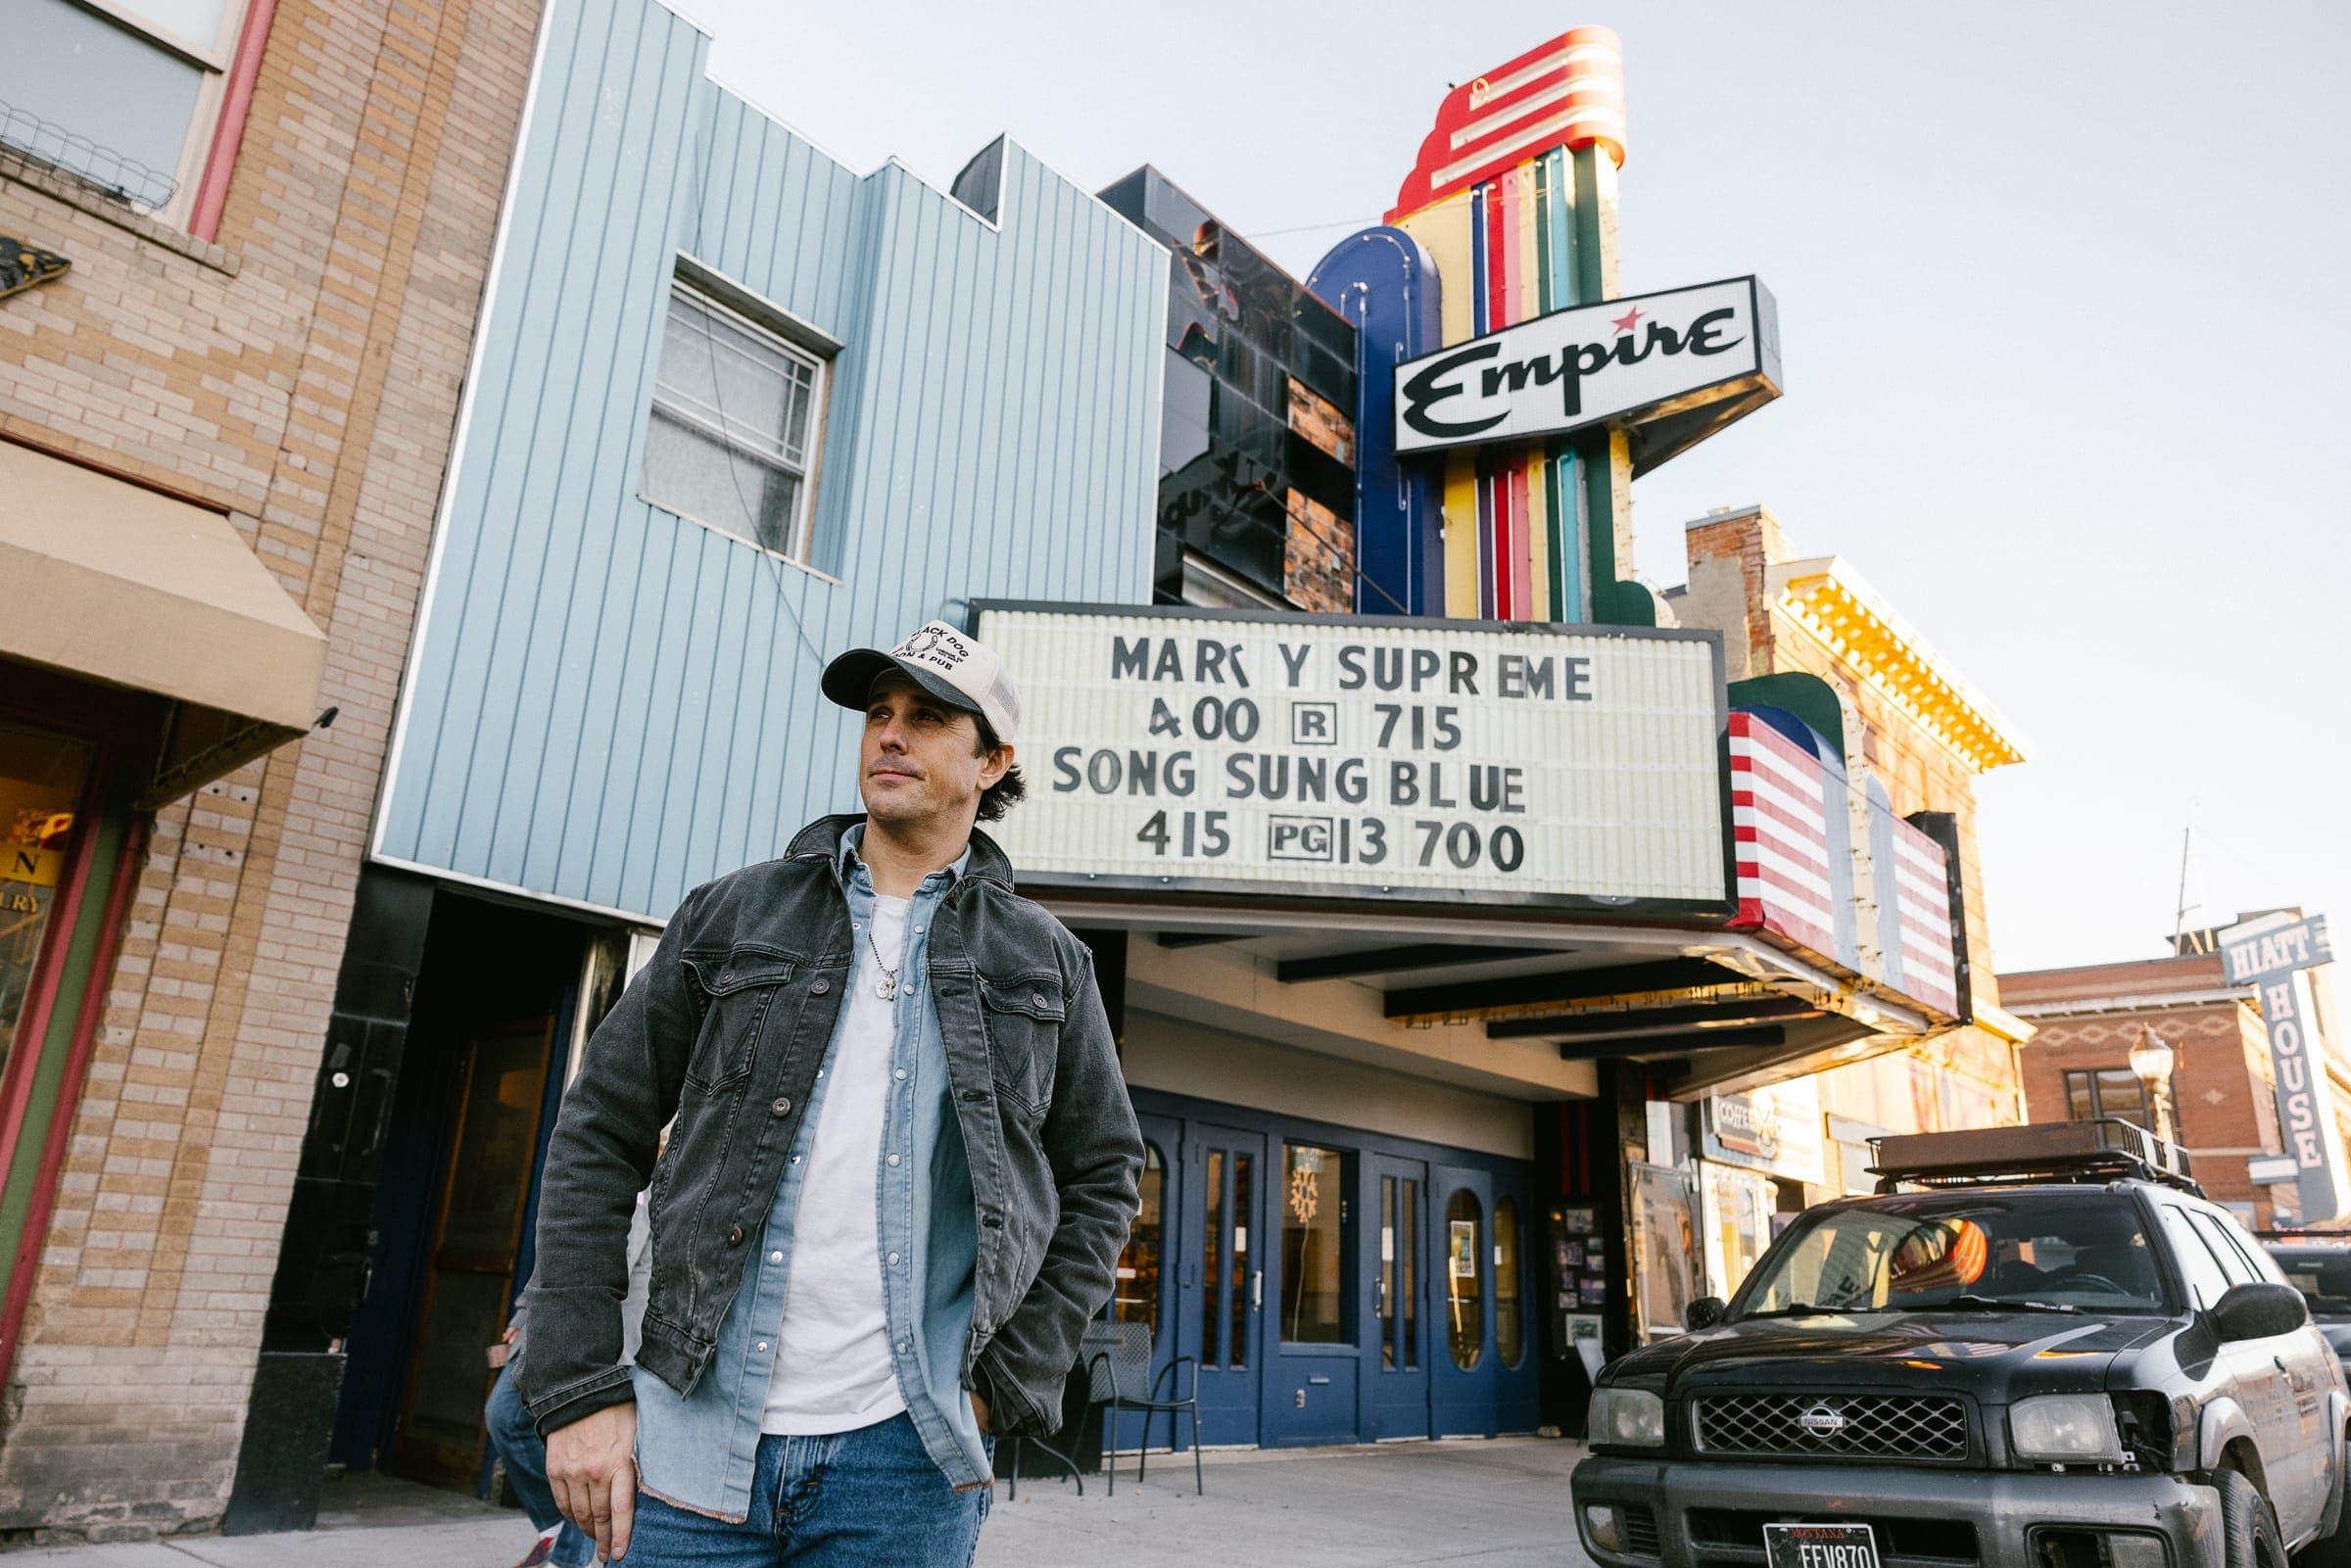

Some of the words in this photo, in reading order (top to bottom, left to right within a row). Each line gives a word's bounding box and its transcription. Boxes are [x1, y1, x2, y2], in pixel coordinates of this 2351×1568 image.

[1402, 307, 1746, 438] Empire
[929, 656, 953, 671] PUB
[946, 637, 969, 657] DOG
[1338, 645, 1593, 701] SUPREME
[1149, 696, 1260, 743] 400
[1301, 710, 1327, 737] R
[1374, 703, 1462, 751] 715
[1053, 746, 1195, 797] SONG
[1225, 752, 1368, 804] SUNG
[1390, 760, 1526, 814] BLUE
[1136, 809, 1230, 858] 415
[1415, 820, 1524, 873] 700
[2229, 924, 2310, 981] HIATT
[2265, 982, 2323, 1169] HOUSE
[1803, 1417, 1839, 1426] NISSAN
[1791, 1528, 1846, 1539] MONTANA
